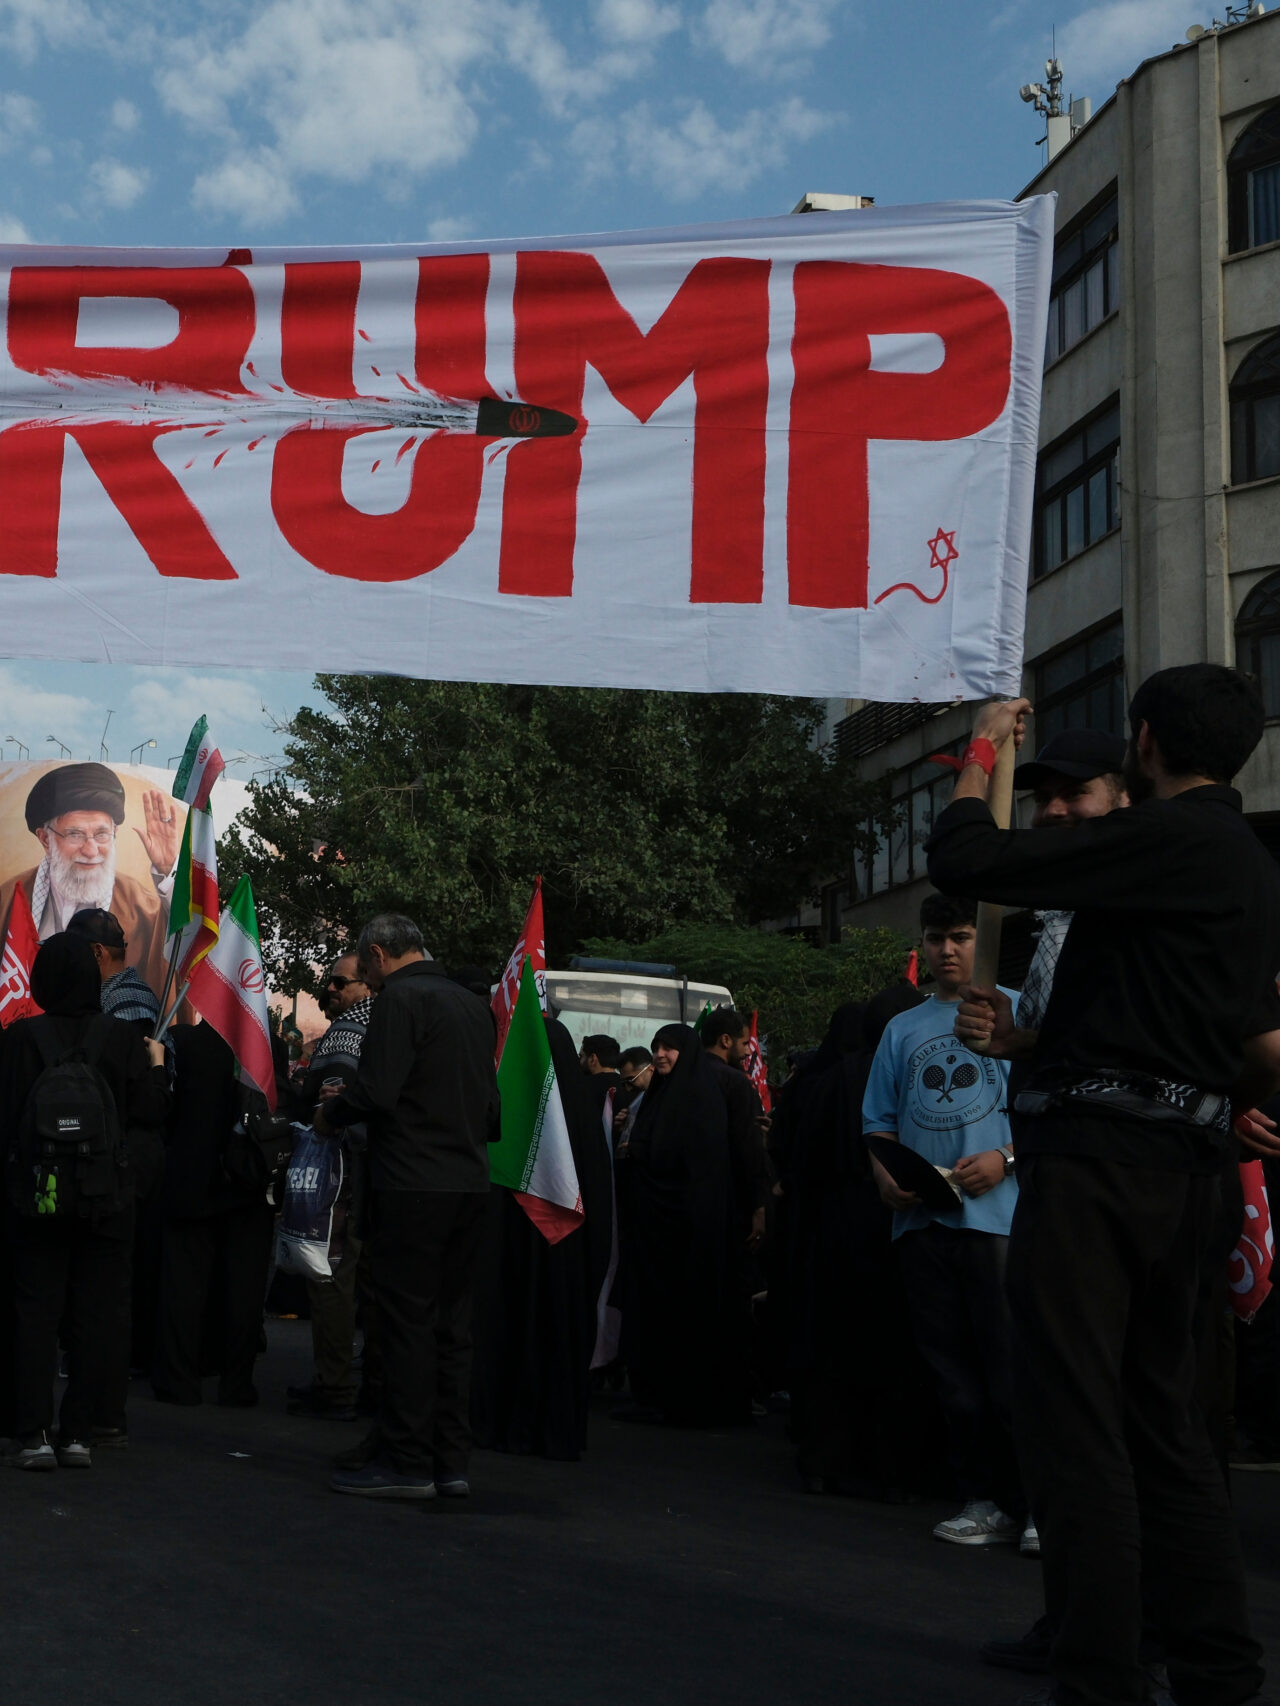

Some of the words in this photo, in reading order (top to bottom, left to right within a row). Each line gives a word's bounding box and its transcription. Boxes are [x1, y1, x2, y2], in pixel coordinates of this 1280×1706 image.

[908, 1041, 947, 1090] CORCUERA
[981, 1056, 996, 1086] CLUB
[58, 1118, 80, 1126] ORIGINAL
[913, 1107, 963, 1124] ESTABLISHED
[964, 1104, 982, 1118] 1969
[286, 1166, 319, 1188] IESEL
